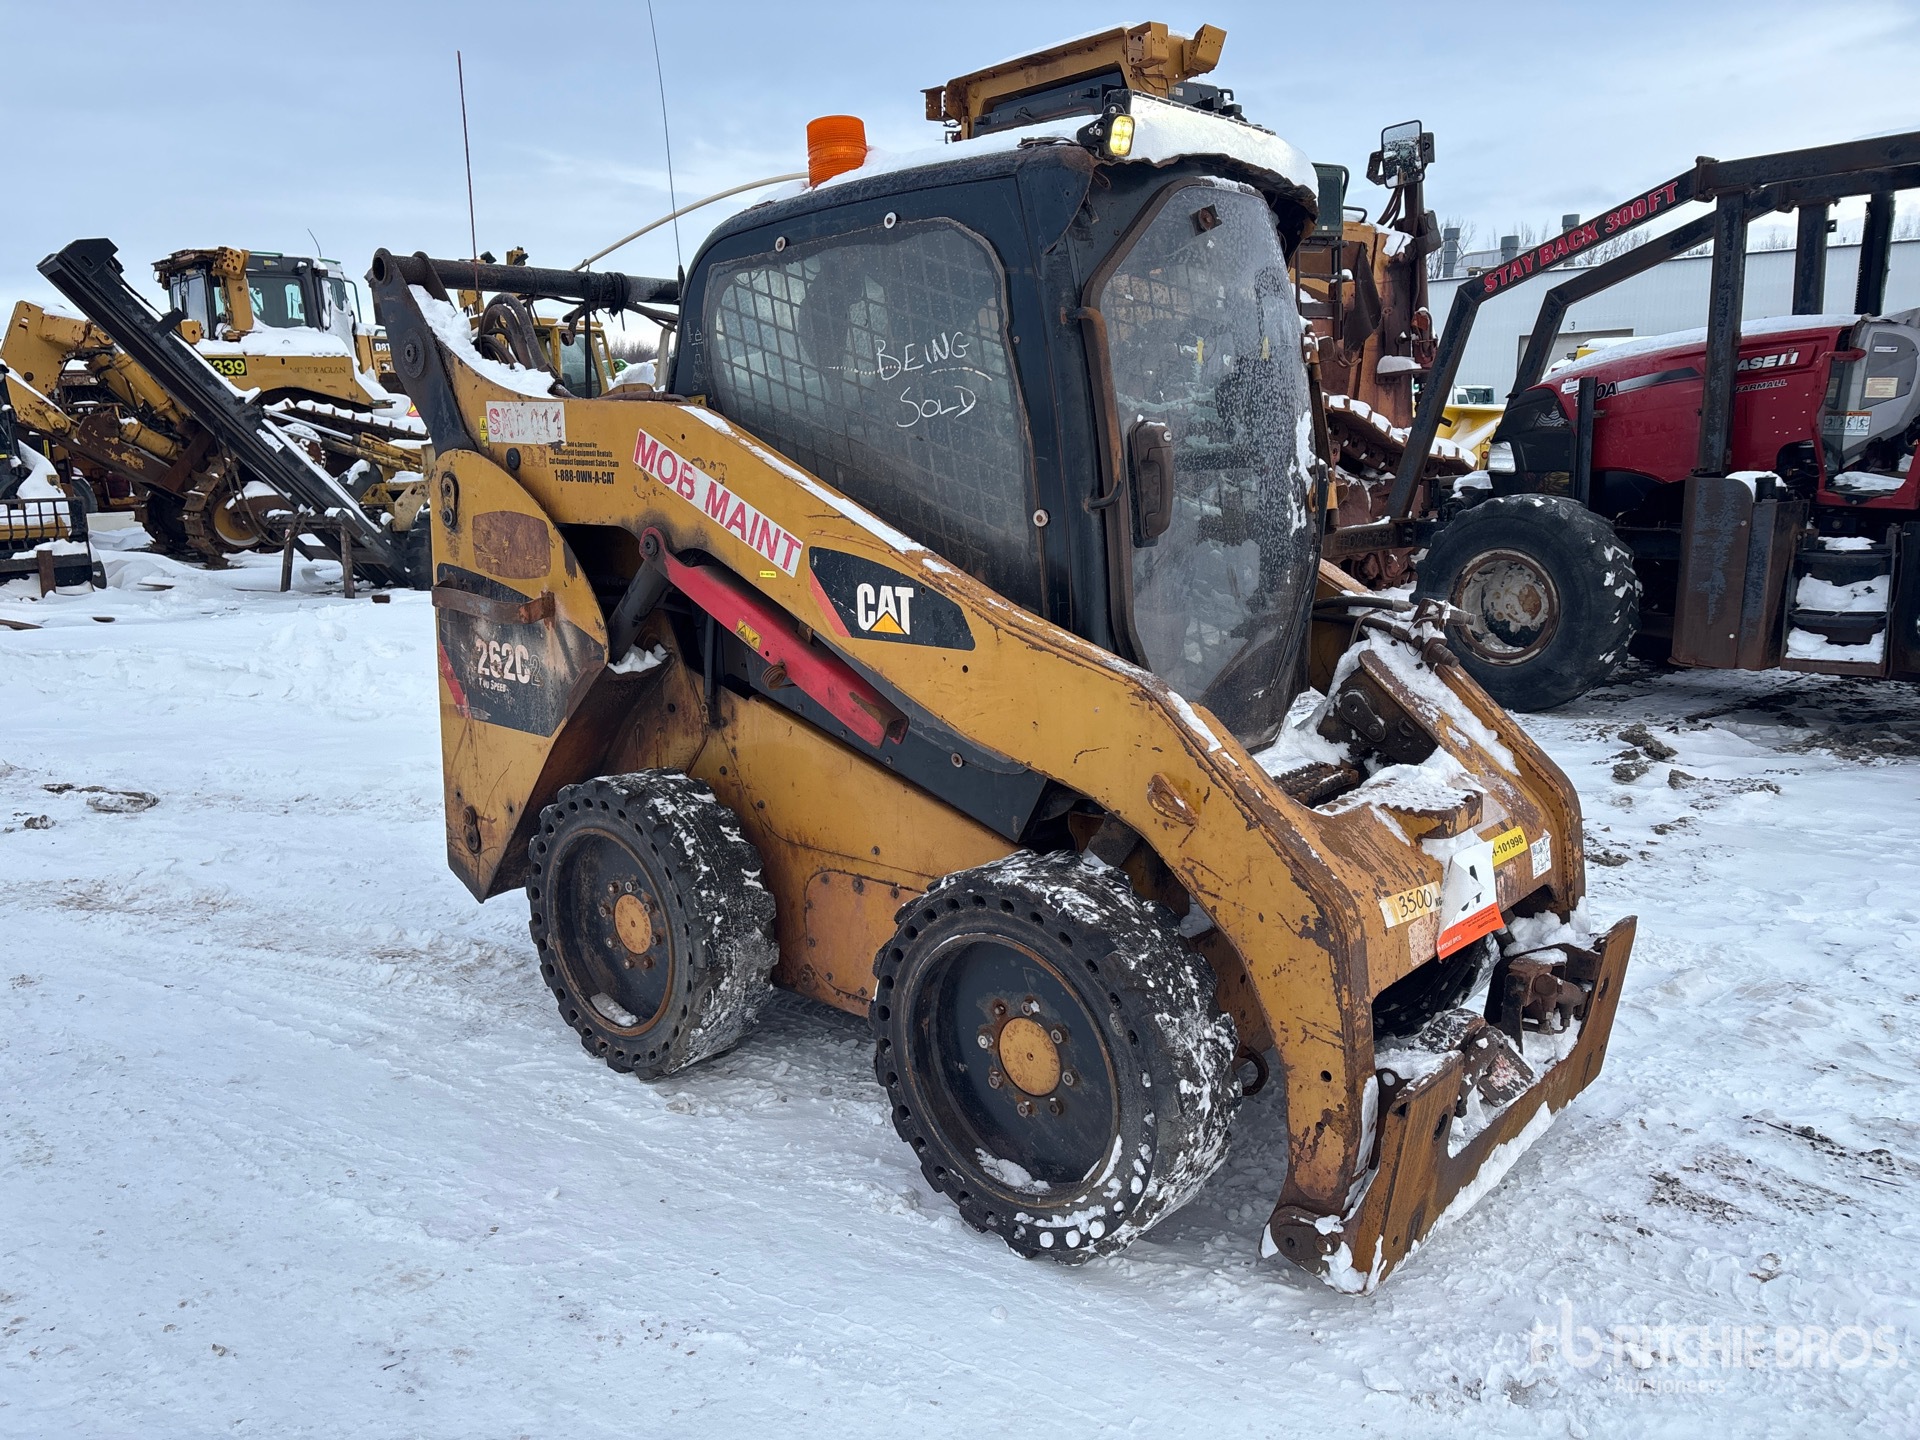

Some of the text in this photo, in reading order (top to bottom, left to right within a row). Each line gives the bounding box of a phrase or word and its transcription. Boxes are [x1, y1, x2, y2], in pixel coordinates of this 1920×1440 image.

[1484, 252, 1535, 293] STAY
[1538, 219, 1600, 267] BACK
[1569, 321, 1576, 331] 3
[211, 359, 246, 376] 339
[875, 332, 970, 380] BEING
[313, 366, 346, 374] RAGLAN
[1736, 379, 1788, 393] FARMALL
[896, 385, 977, 428] SOLD
[574, 458, 595, 466] Equipment
[596, 459, 607, 467] Sales
[554, 469, 615, 484] 1-888-OWN-A-CAT
[704, 480, 802, 571] MAINT
[856, 583, 914, 635] CAT
[1398, 888, 1432, 918] 3500
